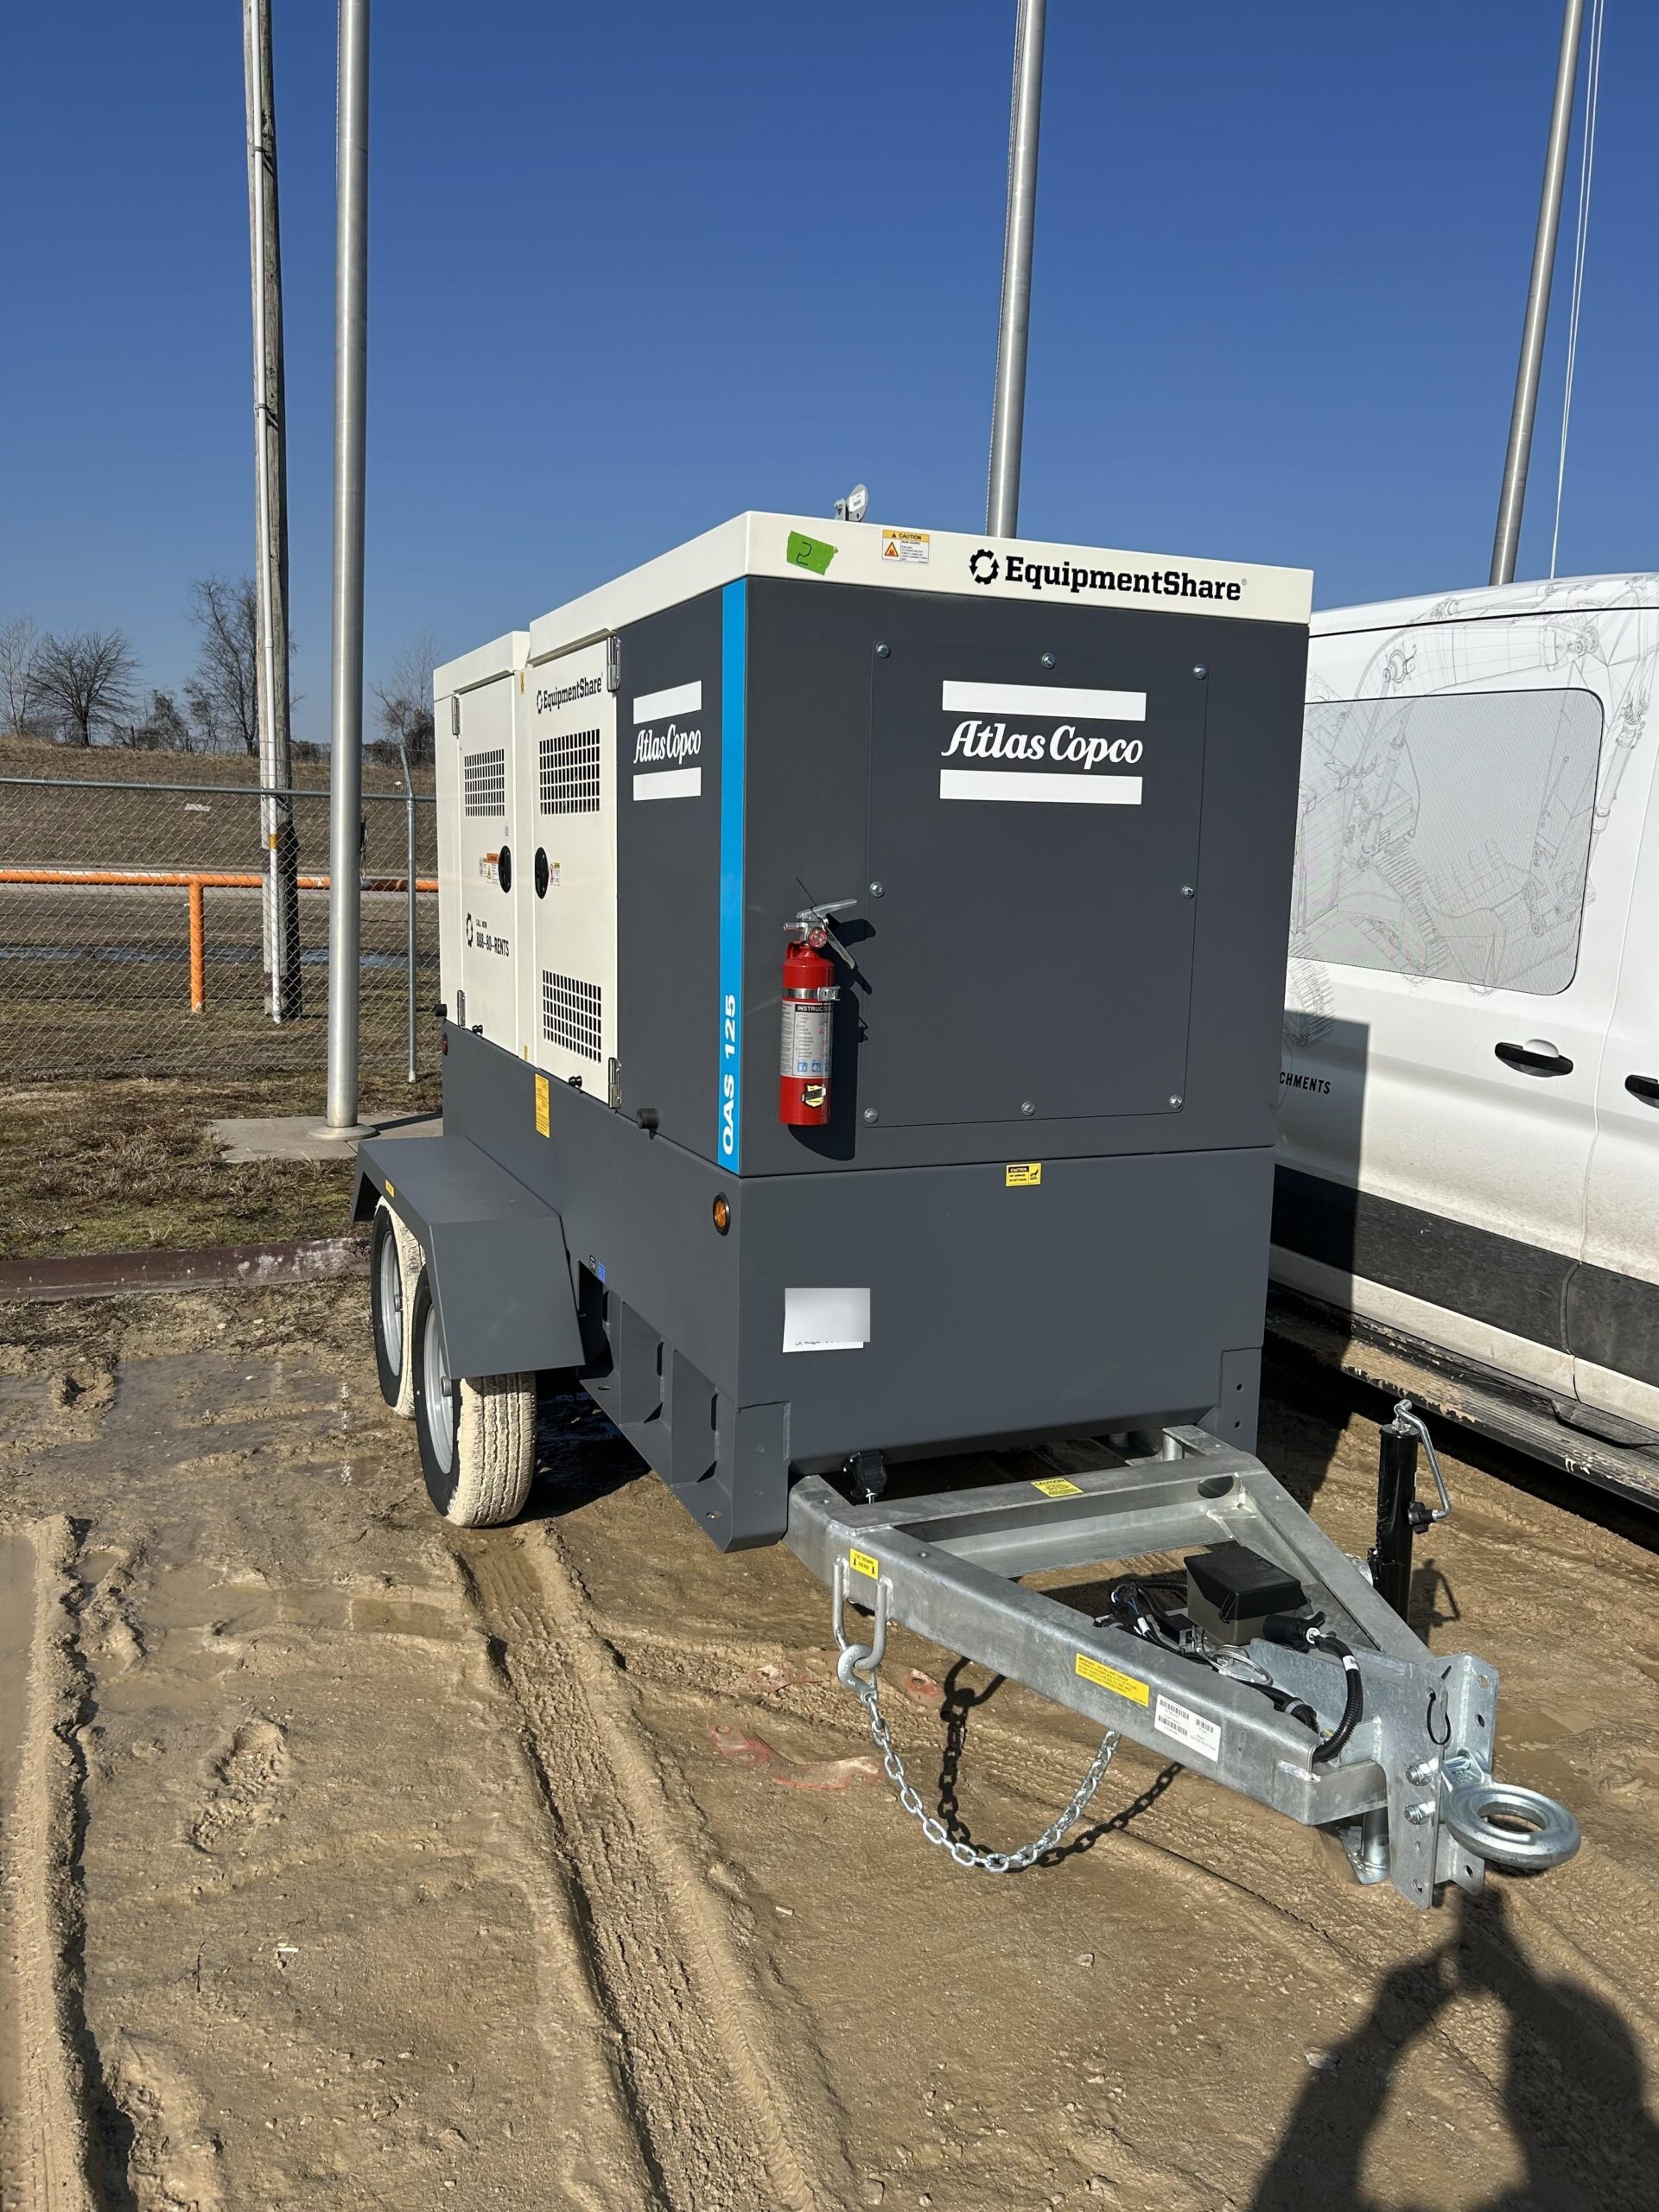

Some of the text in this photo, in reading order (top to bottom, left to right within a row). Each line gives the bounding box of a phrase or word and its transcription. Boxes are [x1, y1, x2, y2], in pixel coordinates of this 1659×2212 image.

[796, 541, 812, 566] 2
[1005, 556, 1242, 601] EquipmentShare
[543, 677, 602, 712] EquipmentShare
[632, 723, 702, 765] Atlas Copco
[941, 720, 1144, 770] Atlas Copco
[722, 995, 736, 1156] QAS 125
